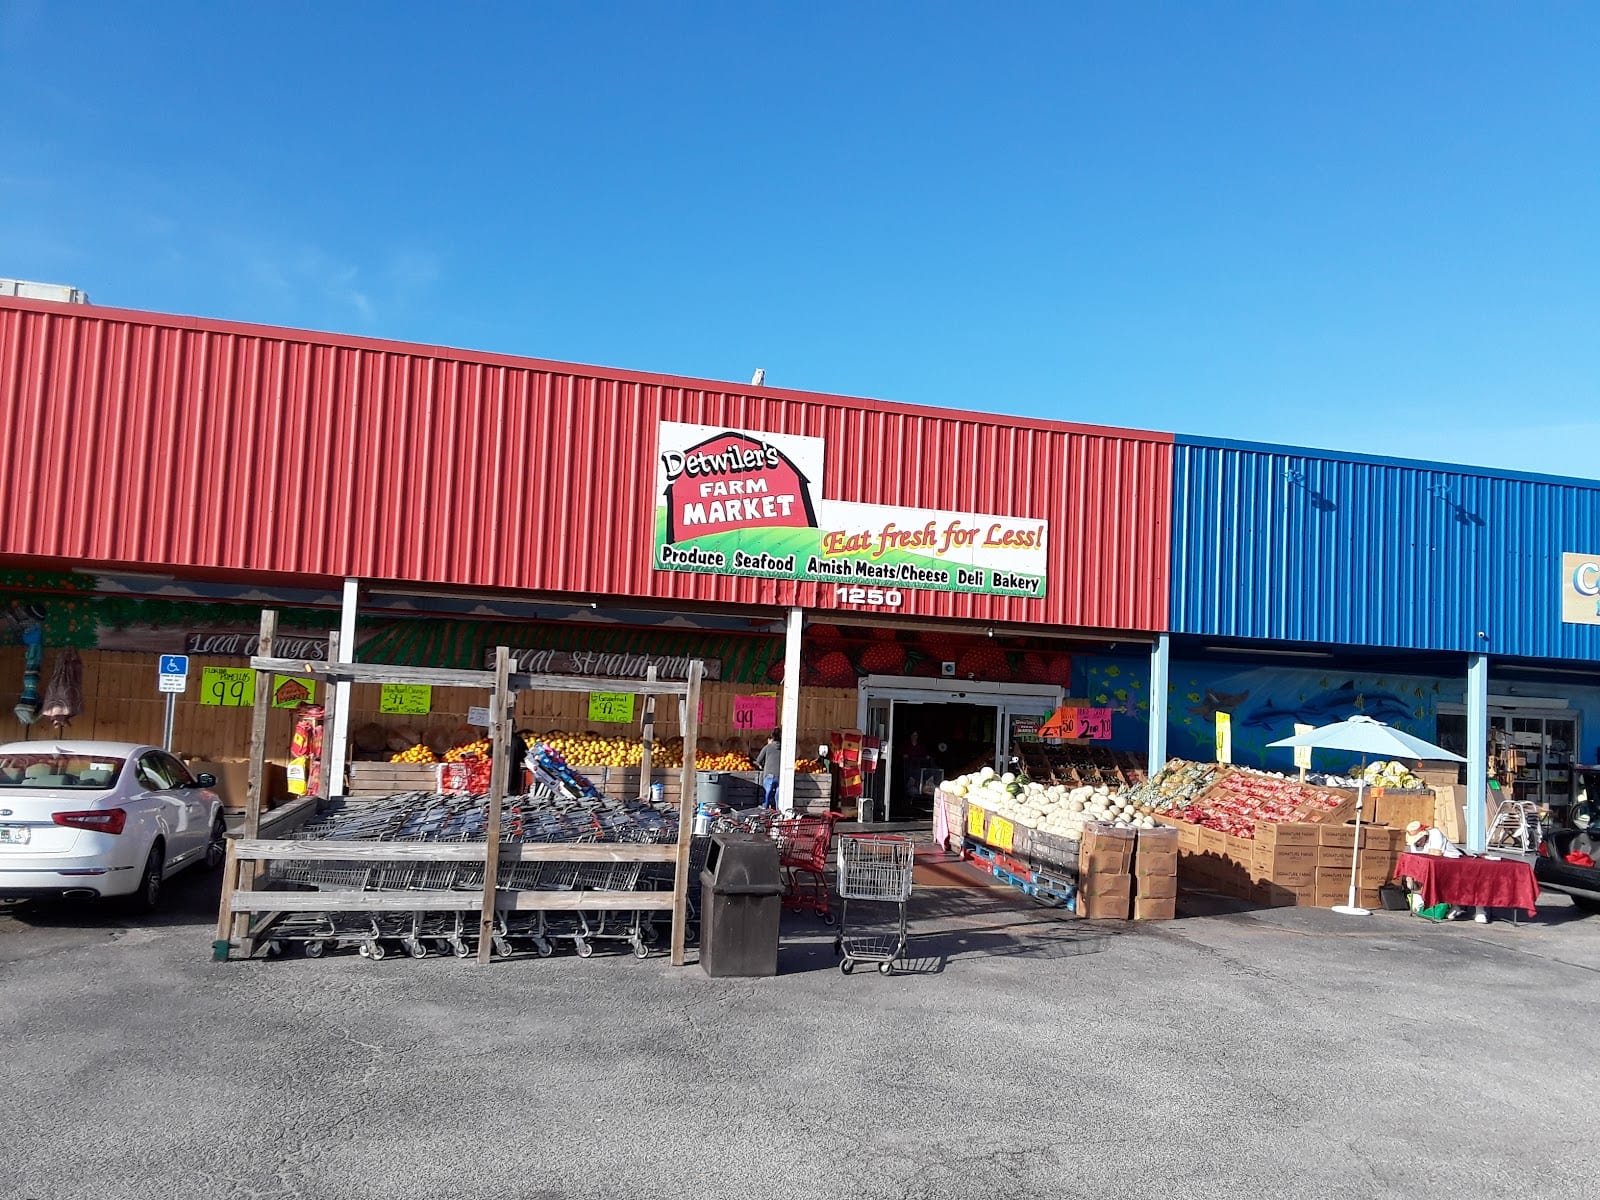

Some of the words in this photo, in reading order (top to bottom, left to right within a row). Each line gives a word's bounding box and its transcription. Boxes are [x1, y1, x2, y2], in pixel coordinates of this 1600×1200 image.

[661, 442, 780, 481] Detwiler's
[699, 478, 769, 498] FARM
[682, 494, 796, 526] MARKET
[823, 529, 872, 555] Eat
[872, 520, 938, 557] fresh
[935, 519, 981, 554] for
[982, 523, 1045, 549] Less!
[661, 546, 724, 566] Produce
[734, 551, 794, 572] Seafood
[807, 557, 852, 577] Amish
[855, 560, 949, 583] Meats/Cheese
[958, 569, 984, 586] Deli
[992, 572, 1039, 592] Bakery
[836, 588, 902, 606] 1250
[189, 633, 240, 655] Local
[244, 634, 329, 660] Onges
